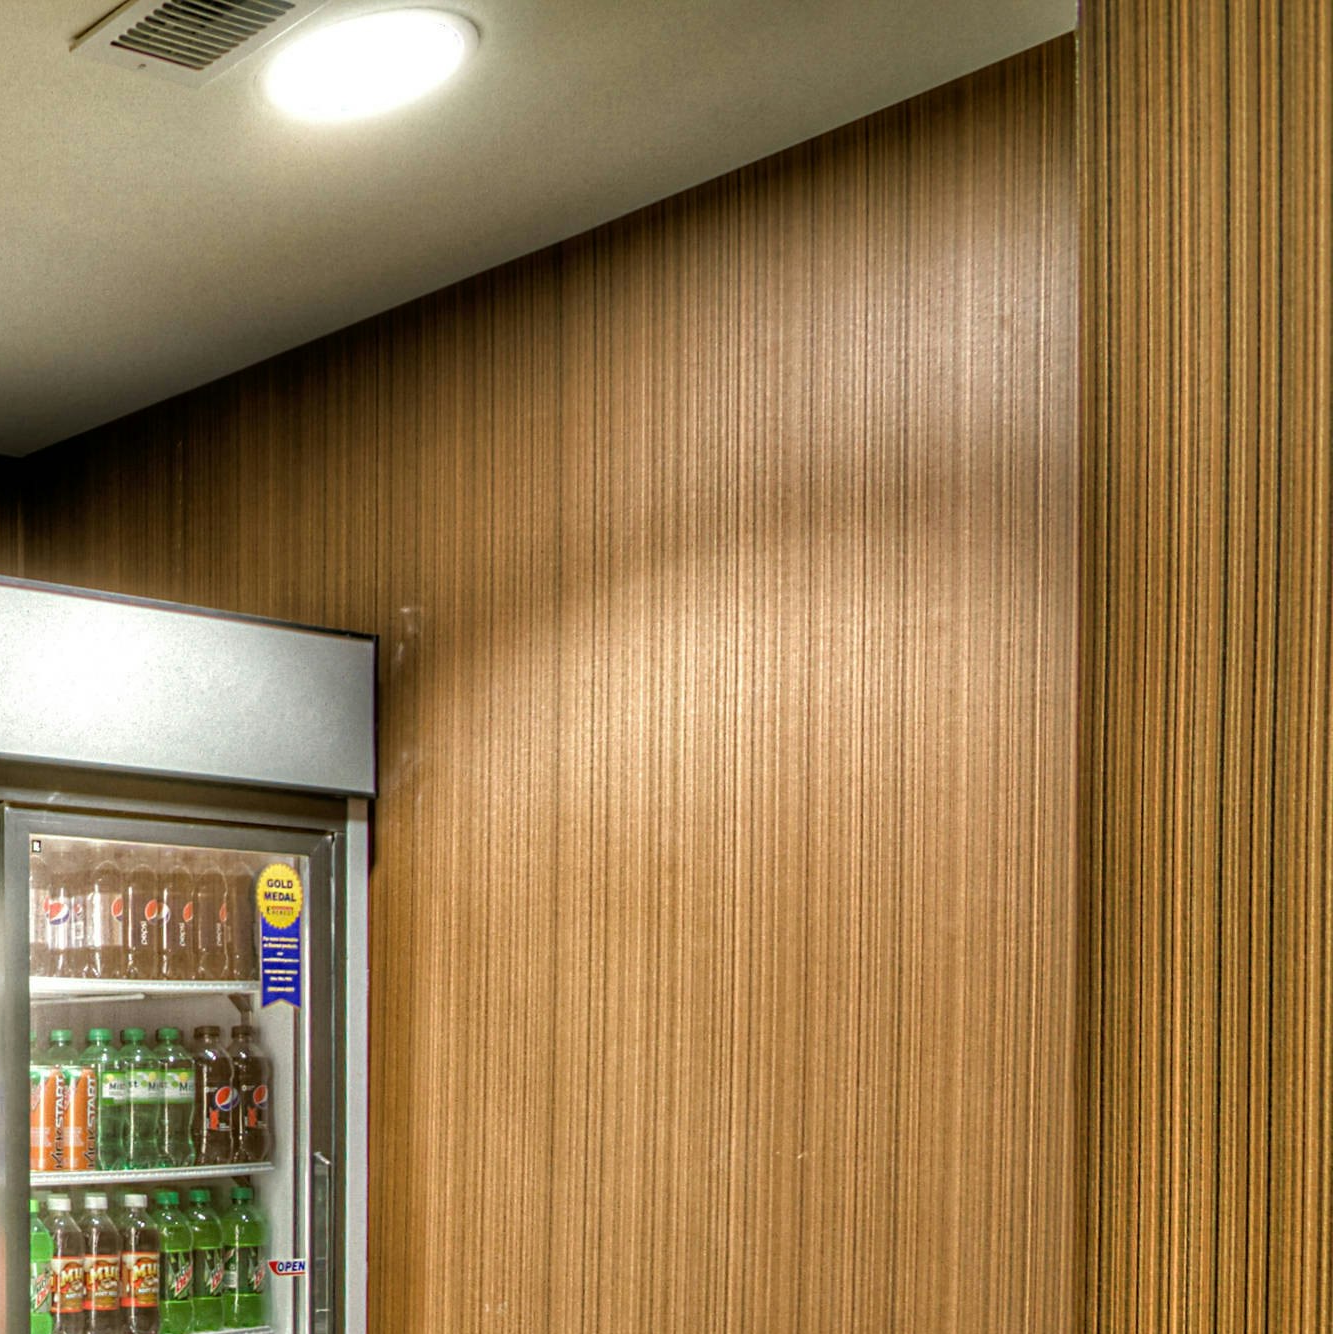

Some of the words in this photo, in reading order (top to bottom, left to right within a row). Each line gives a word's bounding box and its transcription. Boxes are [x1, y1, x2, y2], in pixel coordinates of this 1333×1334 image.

[267, 879, 293, 889] GOLD
[264, 892, 296, 902] MEDAL
[278, 1260, 305, 1272] OPEN
